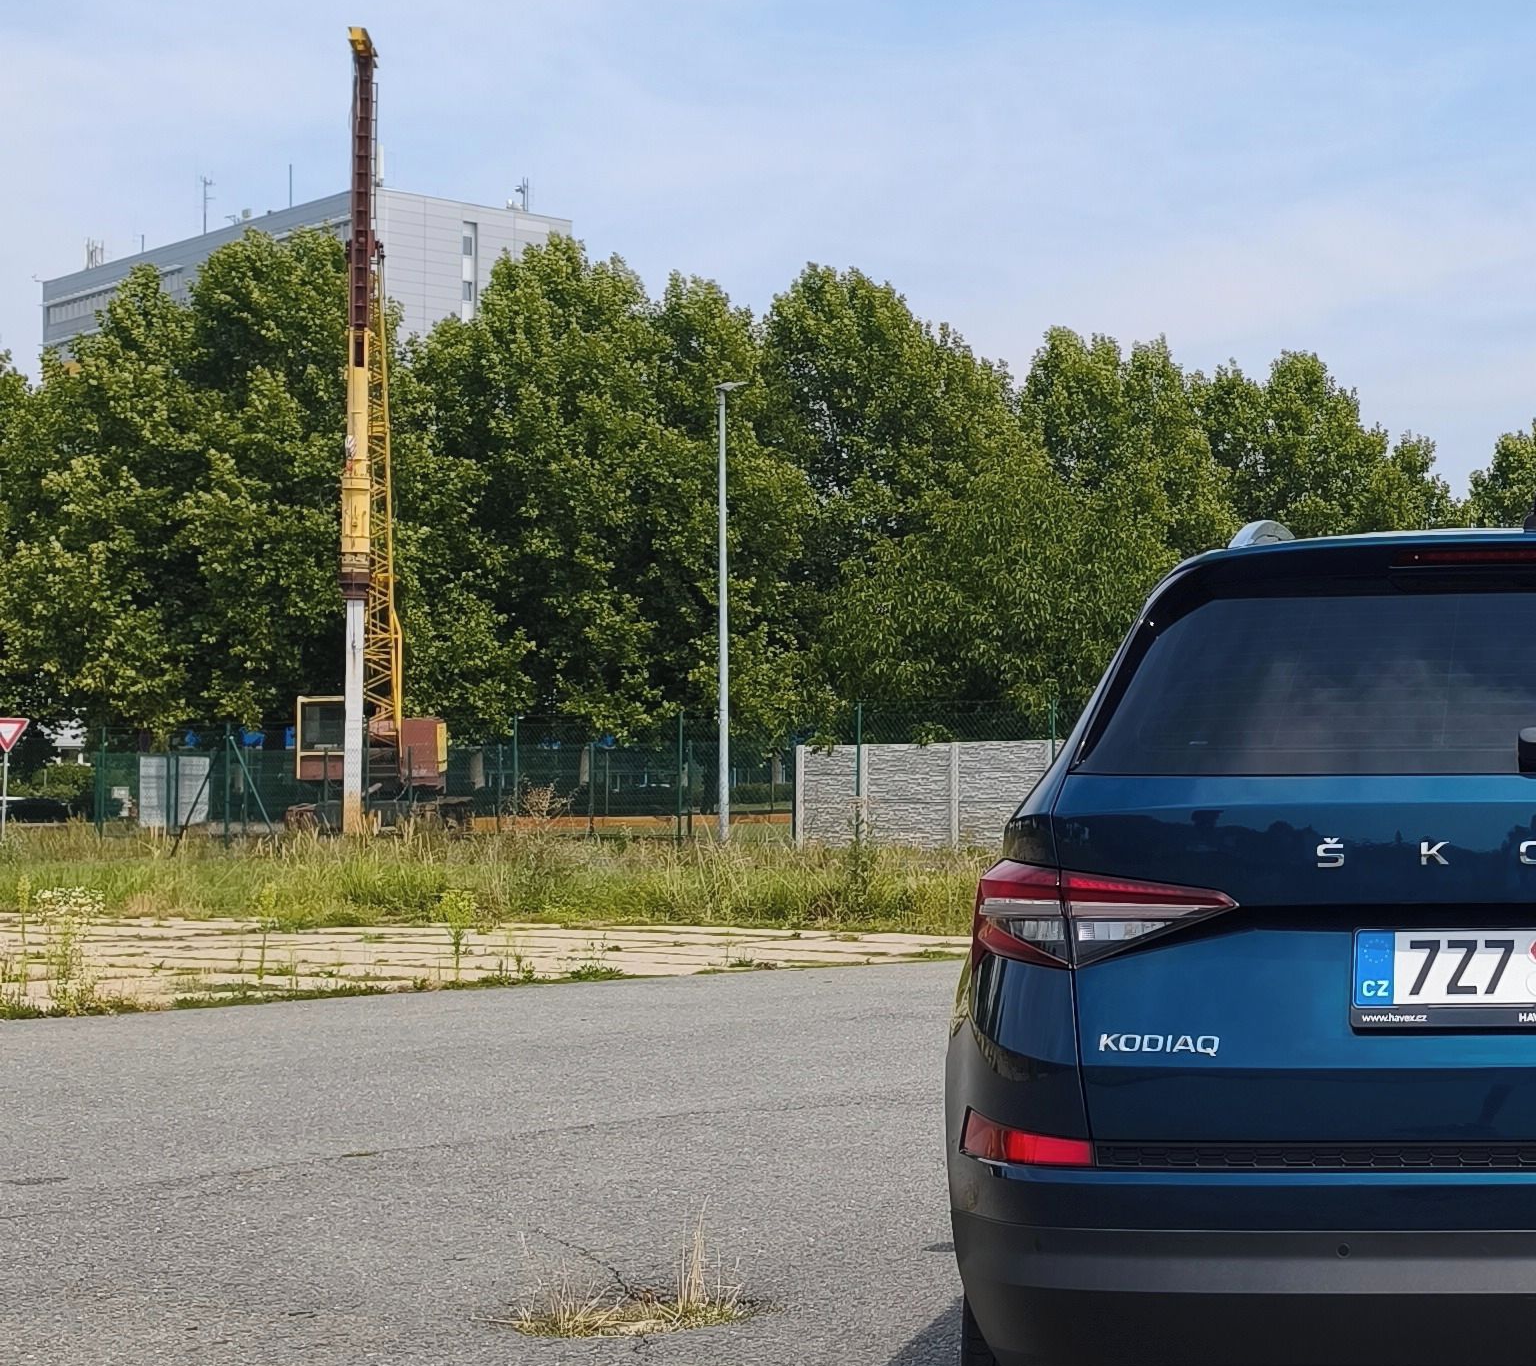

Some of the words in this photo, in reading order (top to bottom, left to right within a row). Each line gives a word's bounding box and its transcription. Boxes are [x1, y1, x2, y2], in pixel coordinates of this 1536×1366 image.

[1409, 939, 1515, 996] 7Z7
[1362, 980, 1389, 997] CZ
[1362, 1013, 1427, 1022] www.havex.cz
[1098, 1033, 1220, 1057] KODIAQ
